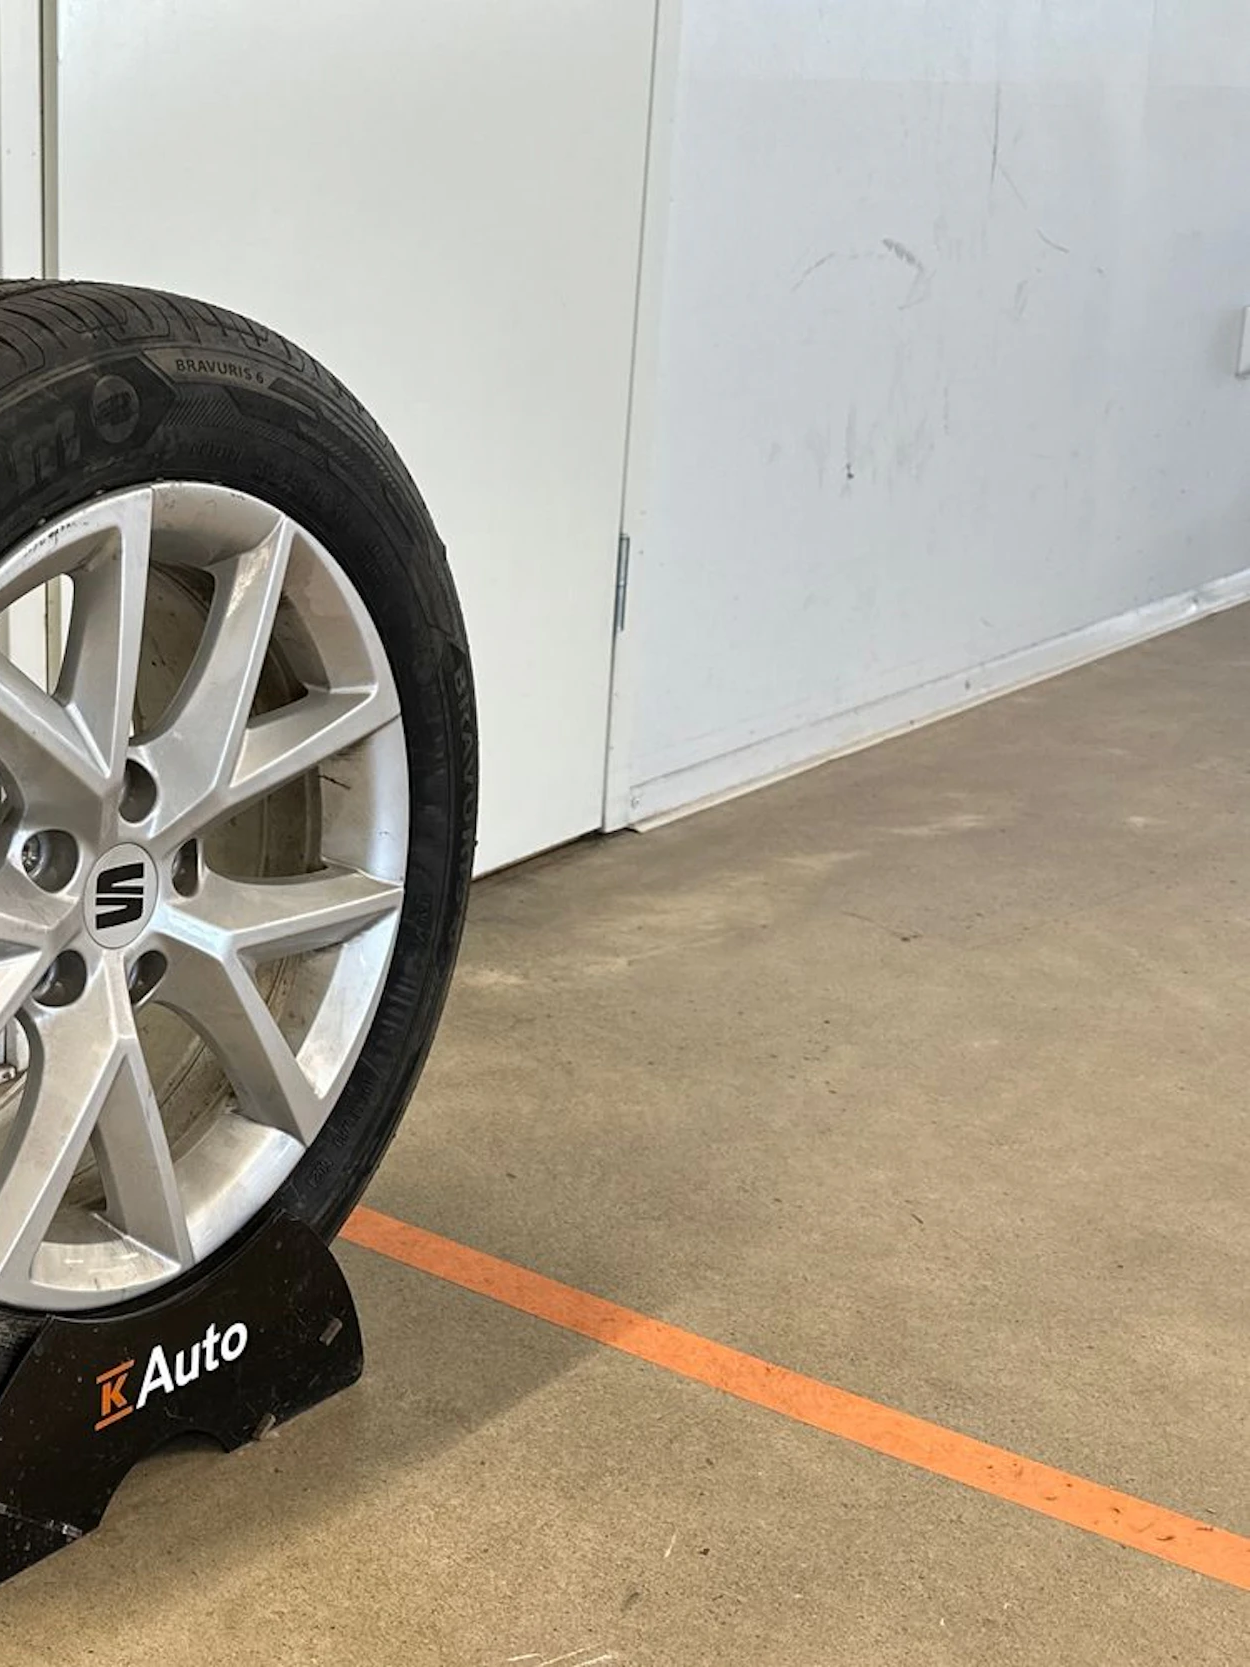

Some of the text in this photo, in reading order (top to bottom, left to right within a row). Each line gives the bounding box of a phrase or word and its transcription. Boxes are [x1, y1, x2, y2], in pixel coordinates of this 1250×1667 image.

[175, 359, 264, 384] BRAVURIS 6
[136, 1322, 248, 1410] Auto
